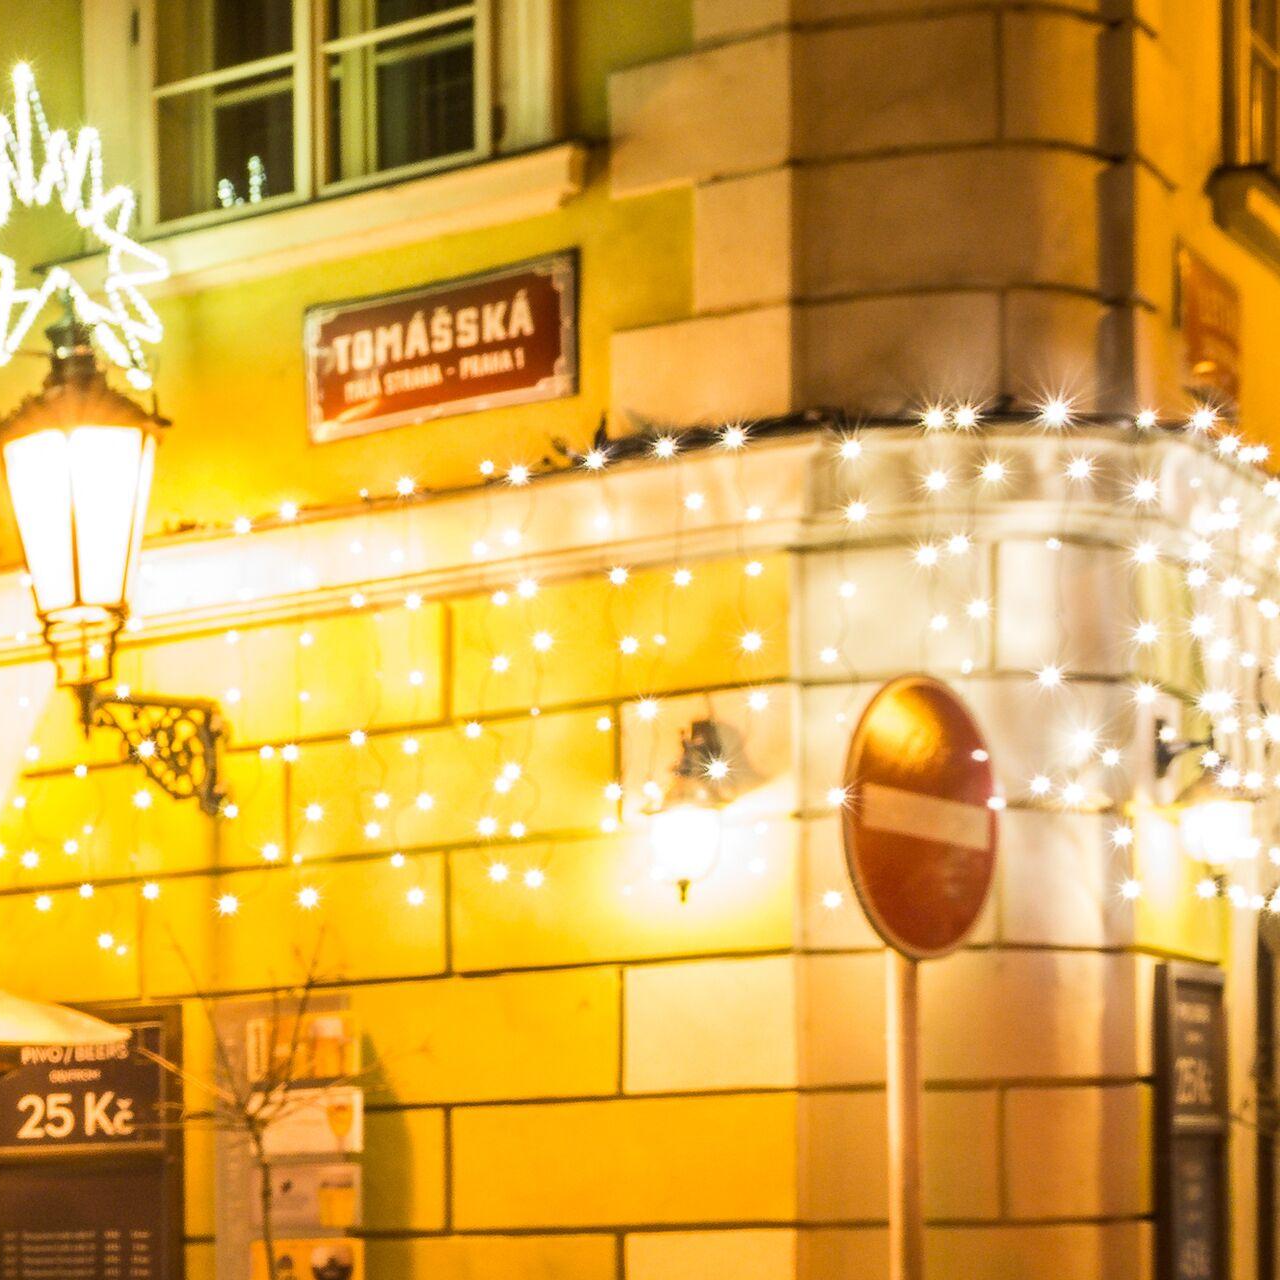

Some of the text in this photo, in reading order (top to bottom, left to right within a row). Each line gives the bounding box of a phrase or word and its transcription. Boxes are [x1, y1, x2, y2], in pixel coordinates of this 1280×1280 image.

[332, 288, 535, 374] TOMÁŠSKÁ
[15, 1090, 136, 1140] 25 Kč
